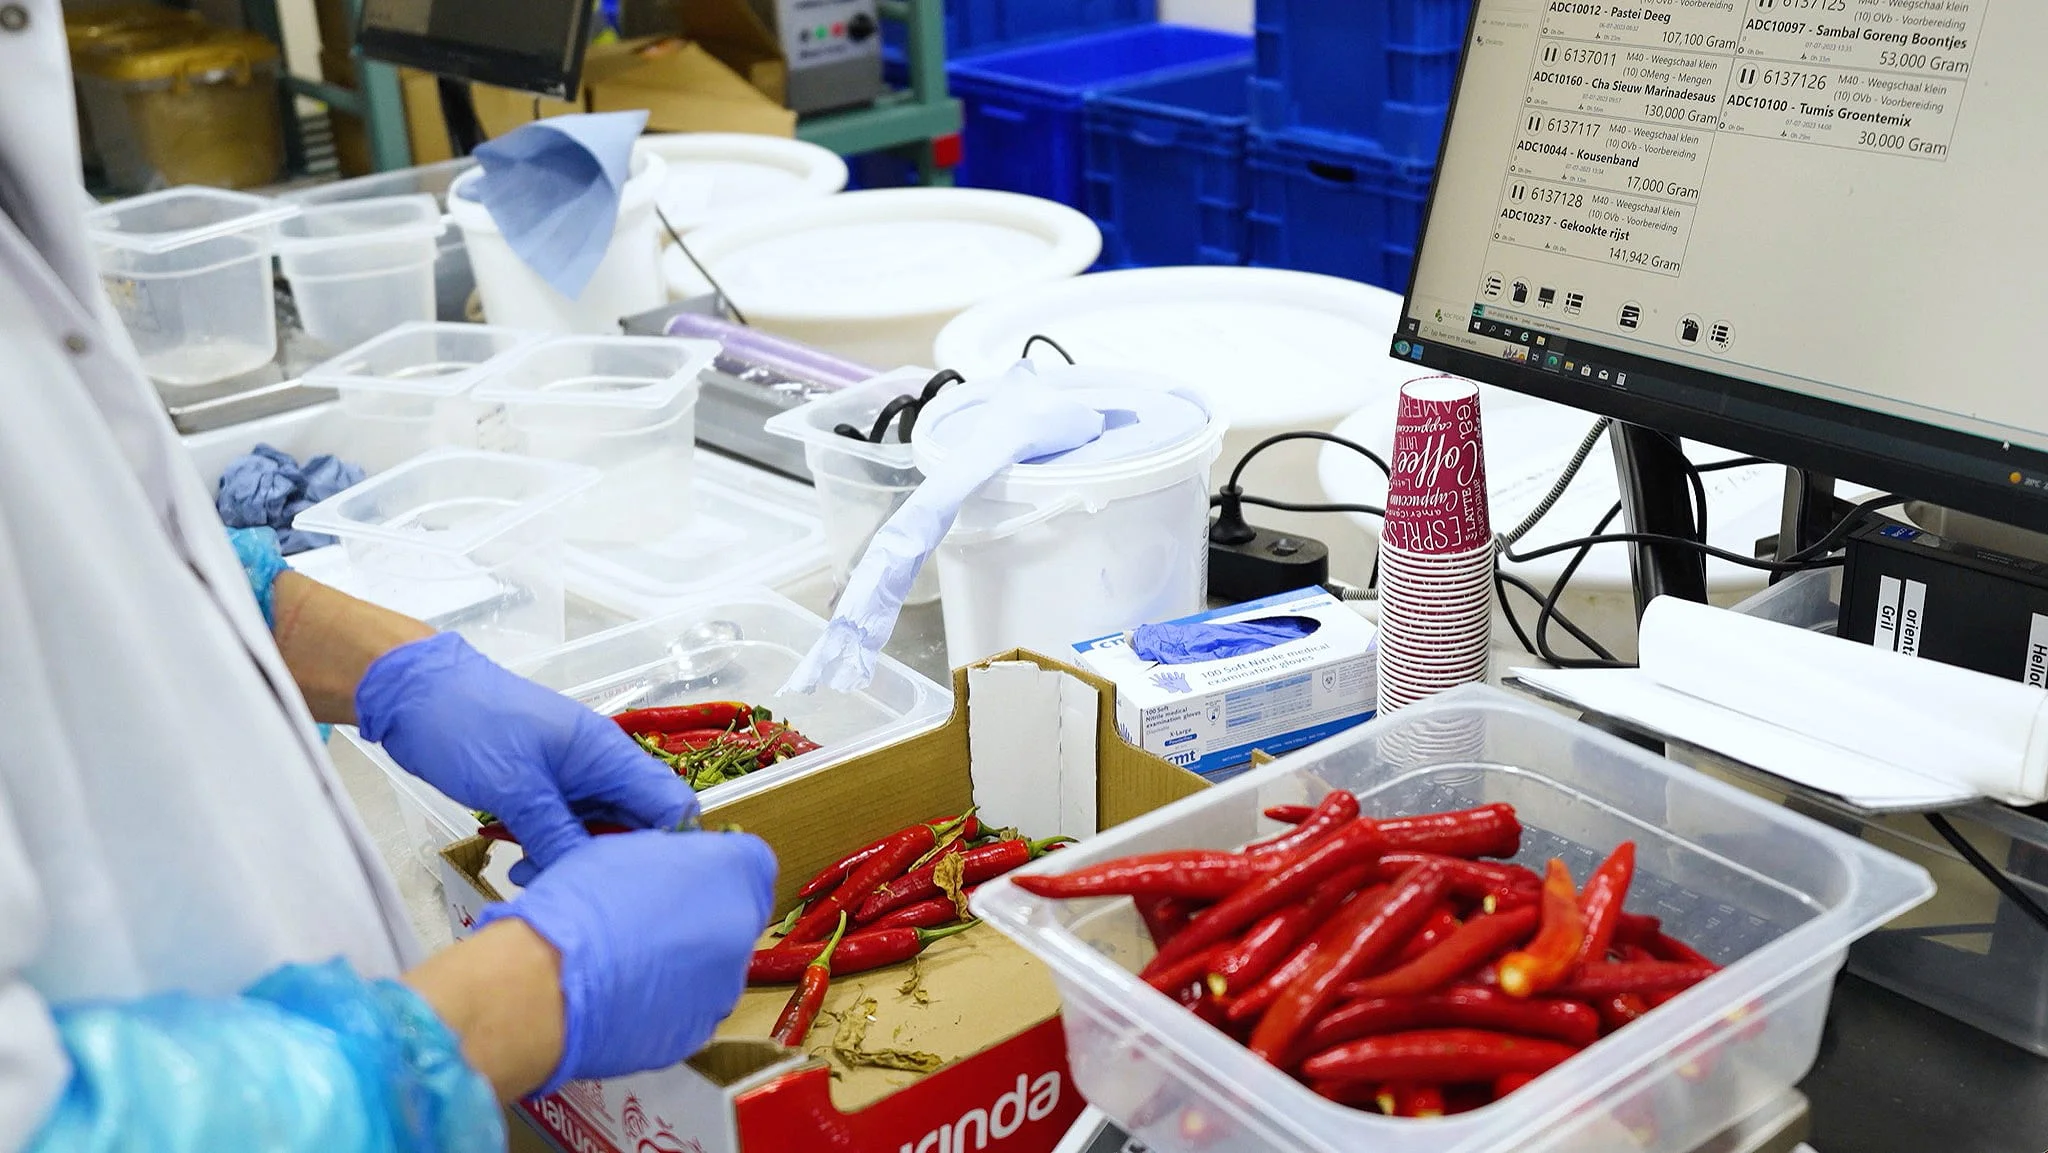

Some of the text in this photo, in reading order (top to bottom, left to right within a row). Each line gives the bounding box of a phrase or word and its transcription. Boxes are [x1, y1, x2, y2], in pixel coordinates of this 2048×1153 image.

[1549, 2, 1602, 16] ADC10012
[1610, 7, 1641, 20] Pastei
[1644, 10, 1671, 24] Deeg
[1888, 0, 1944, 10] Weegschaal
[1946, 1, 1968, 12] klein
[1854, 11, 1871, 22] (10)
[1873, 13, 1893, 23] OVb
[1902, 16, 1966, 31] Voorbereiding
[1662, 31, 1737, 50] 107,100 Gram
[1745, 19, 1806, 34] ADC10097
[1816, 25, 1859, 39] Sambal
[1863, 29, 1908, 46] Goreng
[1911, 33, 1967, 50] Boontjes
[1564, 48, 1616, 66] 6137011
[1626, 52, 1644, 62] M40
[1651, 55, 1697, 70] Weegschaal
[1699, 58, 1717, 70] klein
[1879, 51, 1969, 73] 53,000 Gram
[1533, 71, 1583, 87] ADC10160
[1592, 78, 1610, 90] Cha
[1612, 81, 1642, 93] Sieuw
[1644, 84, 1716, 103] Marinadesaus
[1622, 67, 1639, 78] (10)
[1640, 68, 1669, 84] OMeng
[1678, 73, 1712, 86] Mengen
[1763, 69, 1827, 90] 6137126
[1838, 74, 1859, 85] M40
[1868, 77, 1923, 93] Weegschaal
[1924, 83, 1947, 95] klein
[1727, 94, 1788, 112] ADC10100
[1800, 103, 1834, 118] Tumis
[1838, 107, 1912, 127] Groentemix
[1833, 90, 1851, 102] (10)
[1852, 93, 1872, 103] OVb
[1881, 95, 1944, 114] Voorbereiding
[1644, 105, 1718, 125] 130,000 Gram
[1547, 118, 1601, 138] 6137117
[1608, 123, 1627, 134] M40
[1634, 127, 1679, 142] Weegschaal
[1680, 132, 1699, 144] klein
[1517, 140, 1567, 157] ADC10044
[1576, 148, 1640, 168] Kousenband
[1605, 138, 1620, 150] (10)
[1621, 140, 1637, 150] OVb
[1644, 144, 1697, 161] Voorbereiding
[1858, 131, 1948, 156] 30,000 Gram
[1531, 187, 1584, 208] 6137128
[1626, 176, 1699, 199] 17,000 Gram
[1591, 195, 1609, 205] M40
[1616, 199, 1661, 214] Weegschaal
[1662, 205, 1681, 218] klein
[1500, 208, 1551, 225] ADC10237
[1560, 219, 1608, 237] Gekookte
[1609, 227, 1630, 241] rijst
[1588, 209, 1603, 220] (10)
[1603, 212, 1620, 222] OVb
[1626, 216, 1678, 235] Voorbereiding
[1609, 247, 1681, 272] 141,942 Gram
[1397, 433, 1478, 489] Coffee
[1462, 487, 1476, 533] LATTE
[1880, 605, 1896, 631] Gril
[1201, 642, 1330, 679] 100 Soft Nitrile medical
[1207, 655, 1314, 686] examination gloves
[1145, 707, 1188, 722] Nitrile medical
[1146, 711, 1201, 728] examination gloves
[1157, 705, 1169, 713] Soft
[899, 1071, 1061, 1153] rinda
